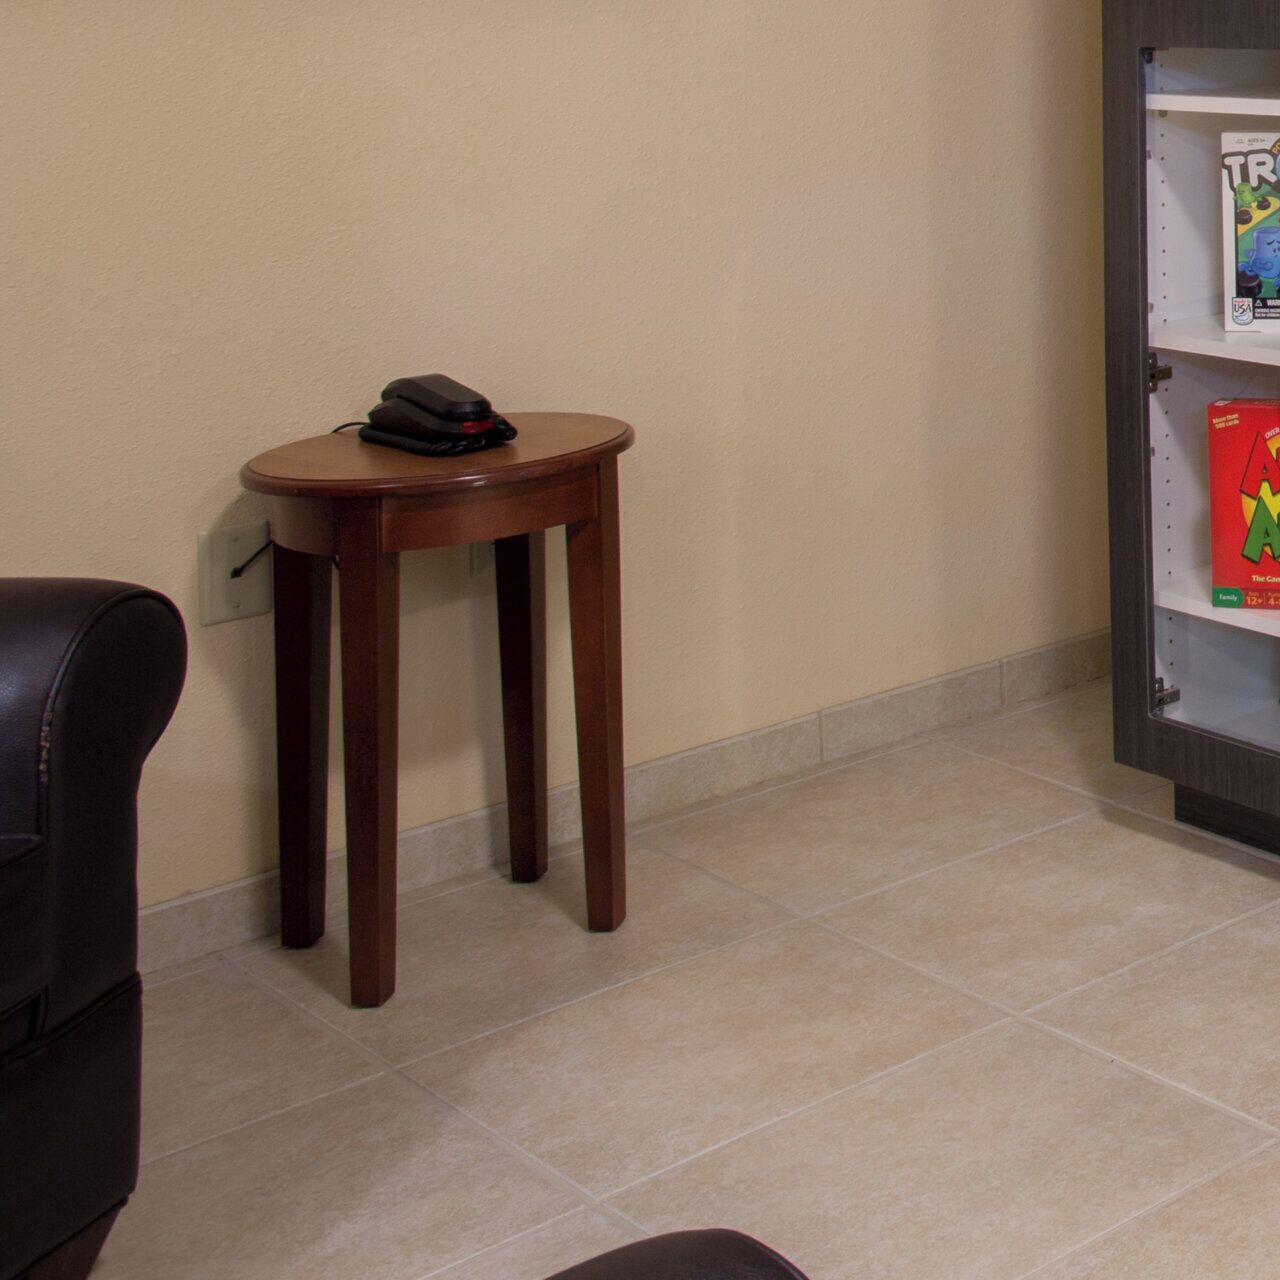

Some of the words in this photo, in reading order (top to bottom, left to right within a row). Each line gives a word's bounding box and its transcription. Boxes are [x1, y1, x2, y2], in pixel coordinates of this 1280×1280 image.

[1234, 303, 1252, 315] USA
[1252, 575, 1265, 583] The
[1219, 594, 1238, 602] Family
[1246, 596, 1263, 605] 12+
